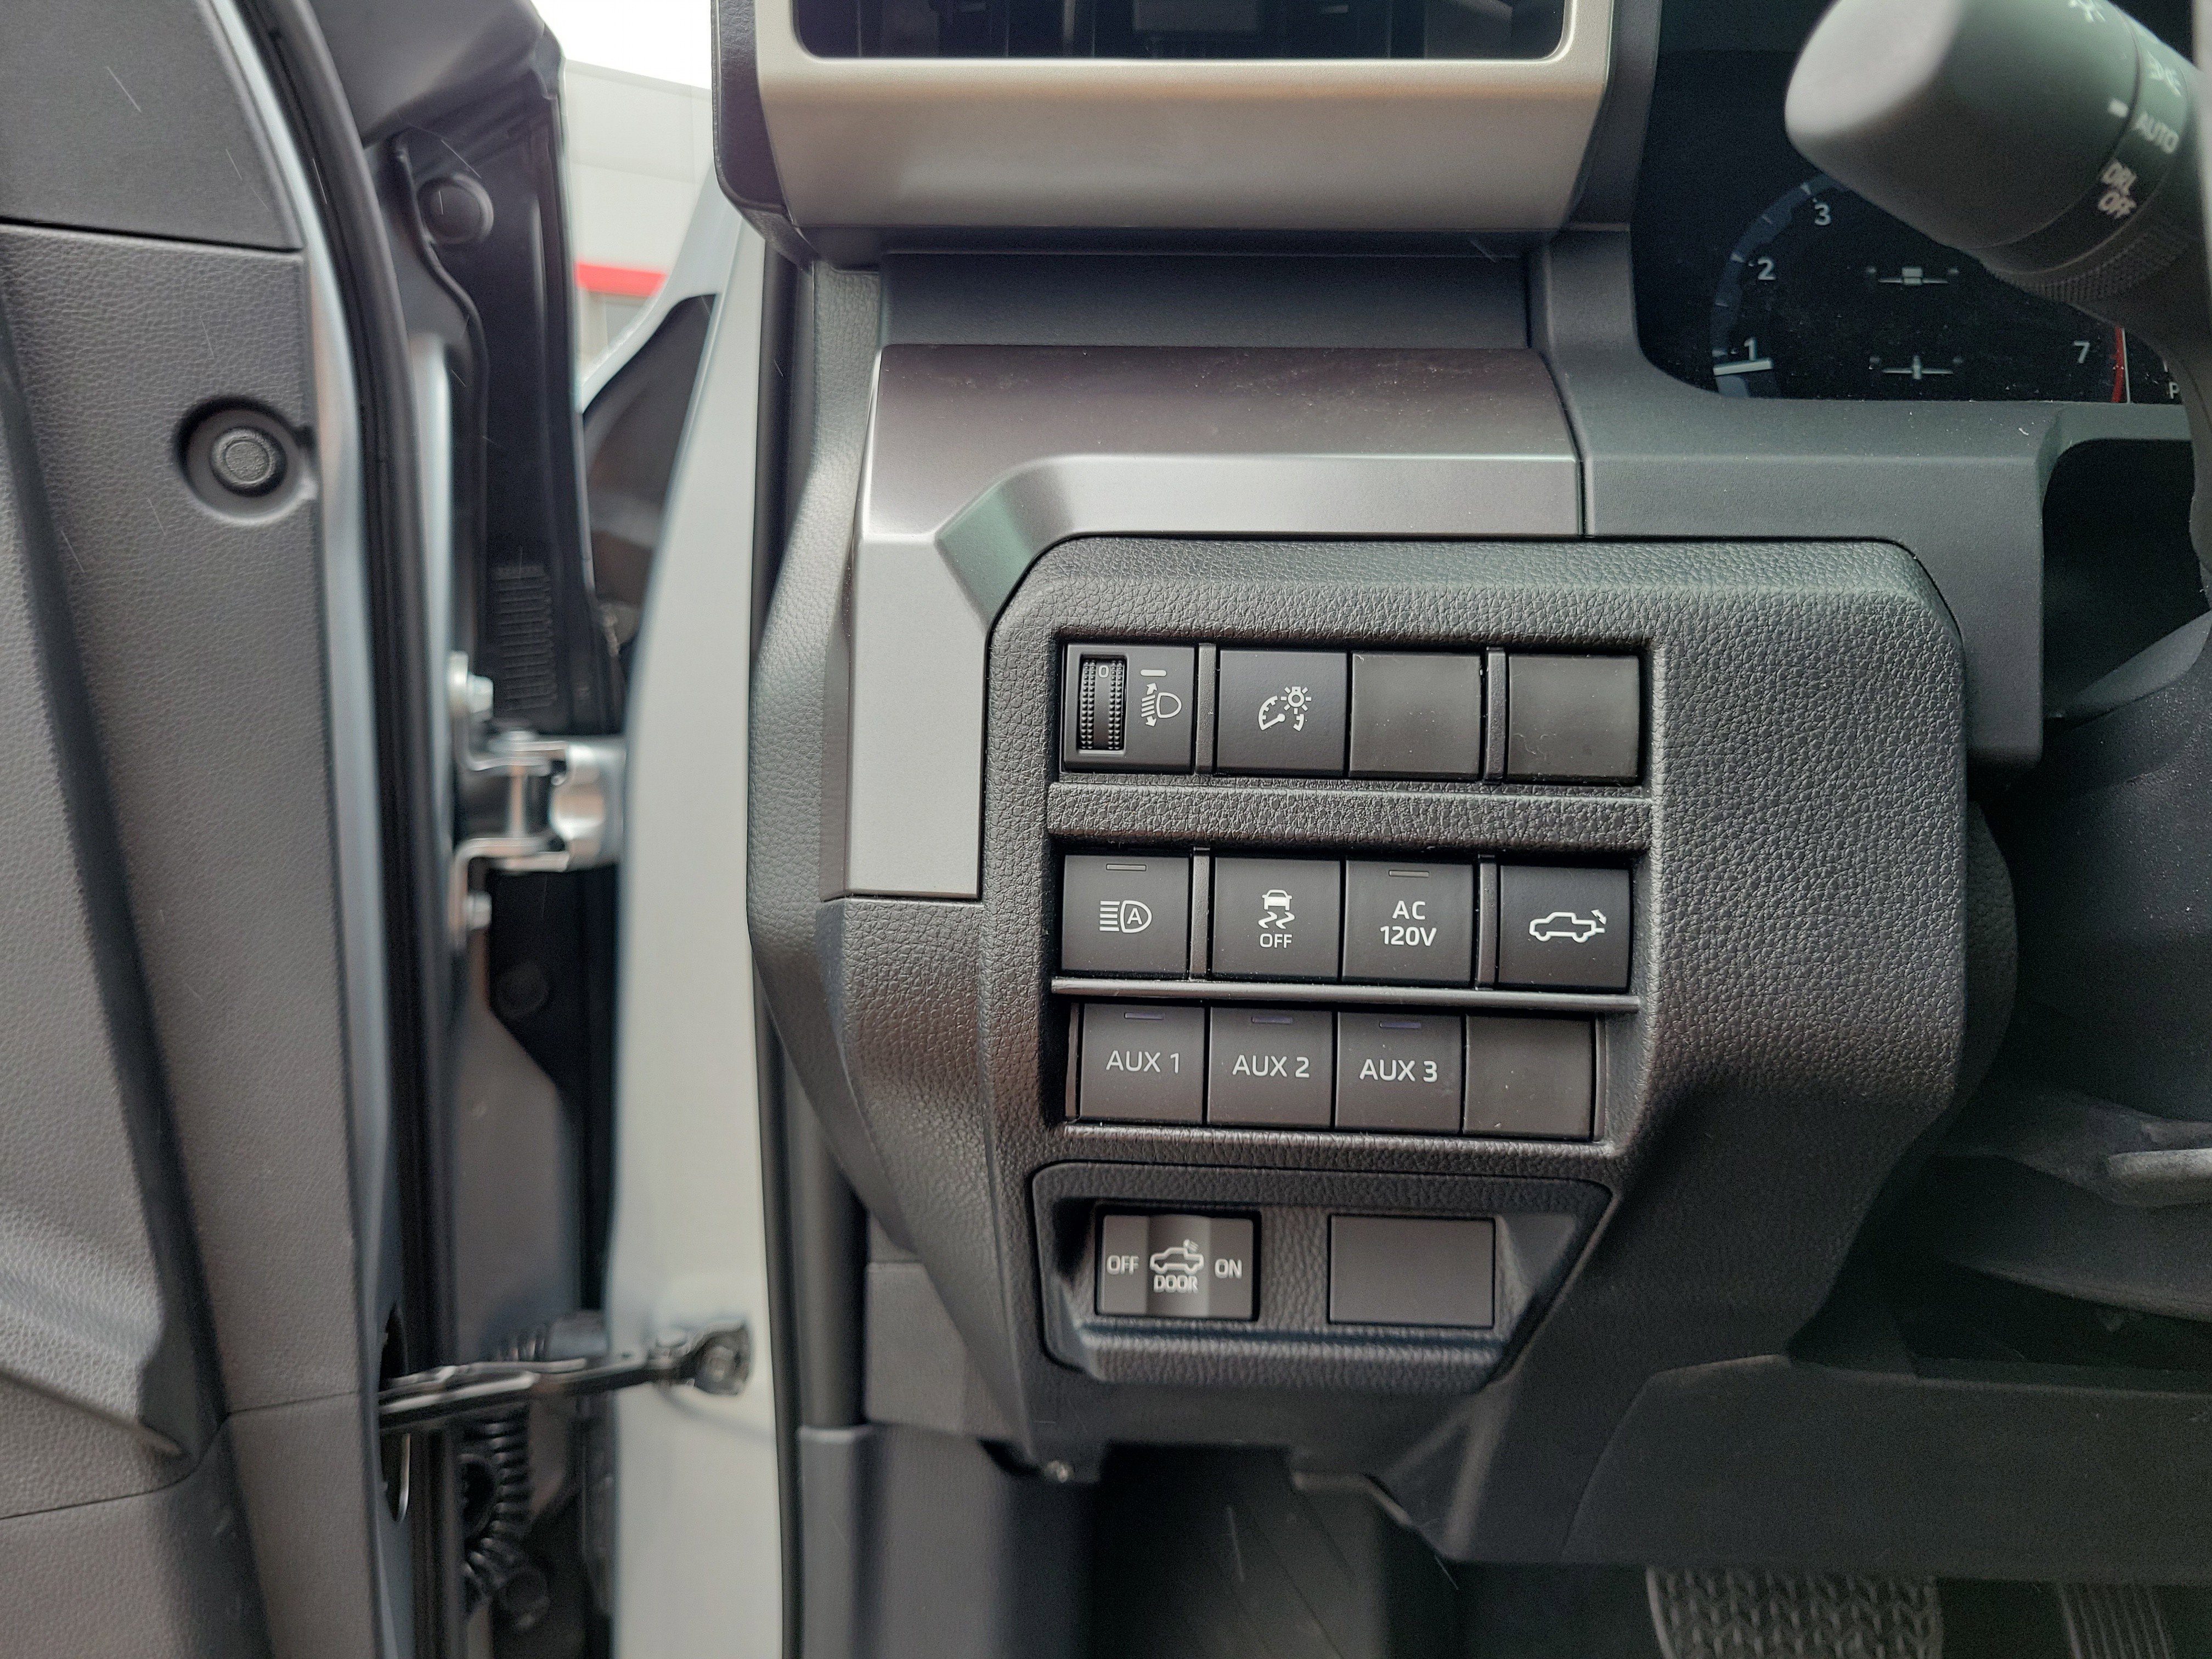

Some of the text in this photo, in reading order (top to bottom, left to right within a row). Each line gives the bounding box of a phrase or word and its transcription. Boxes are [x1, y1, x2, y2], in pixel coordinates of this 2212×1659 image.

[2134, 112, 2180, 154] AUTO
[1814, 203, 1832, 226] 3
[2098, 192, 2137, 218] OFF
[1756, 258, 1777, 281] 2
[1745, 338, 1758, 360] 1
[2075, 340, 2091, 364] 7
[2169, 382, 2180, 399] P
[1126, 908, 1142, 924] A
[1392, 901, 1427, 920] AC
[1259, 934, 1293, 949] OFF
[1380, 927, 1437, 947] 120V
[1105, 1051, 1180, 1074] AUX 1
[1232, 1056, 1311, 1079] AUX 2
[1359, 1059, 1438, 1083] AUX 3
[1106, 1256, 1139, 1274] OFF
[1214, 1259, 1242, 1279] ON
[1153, 1276, 1198, 1293] DOOR
